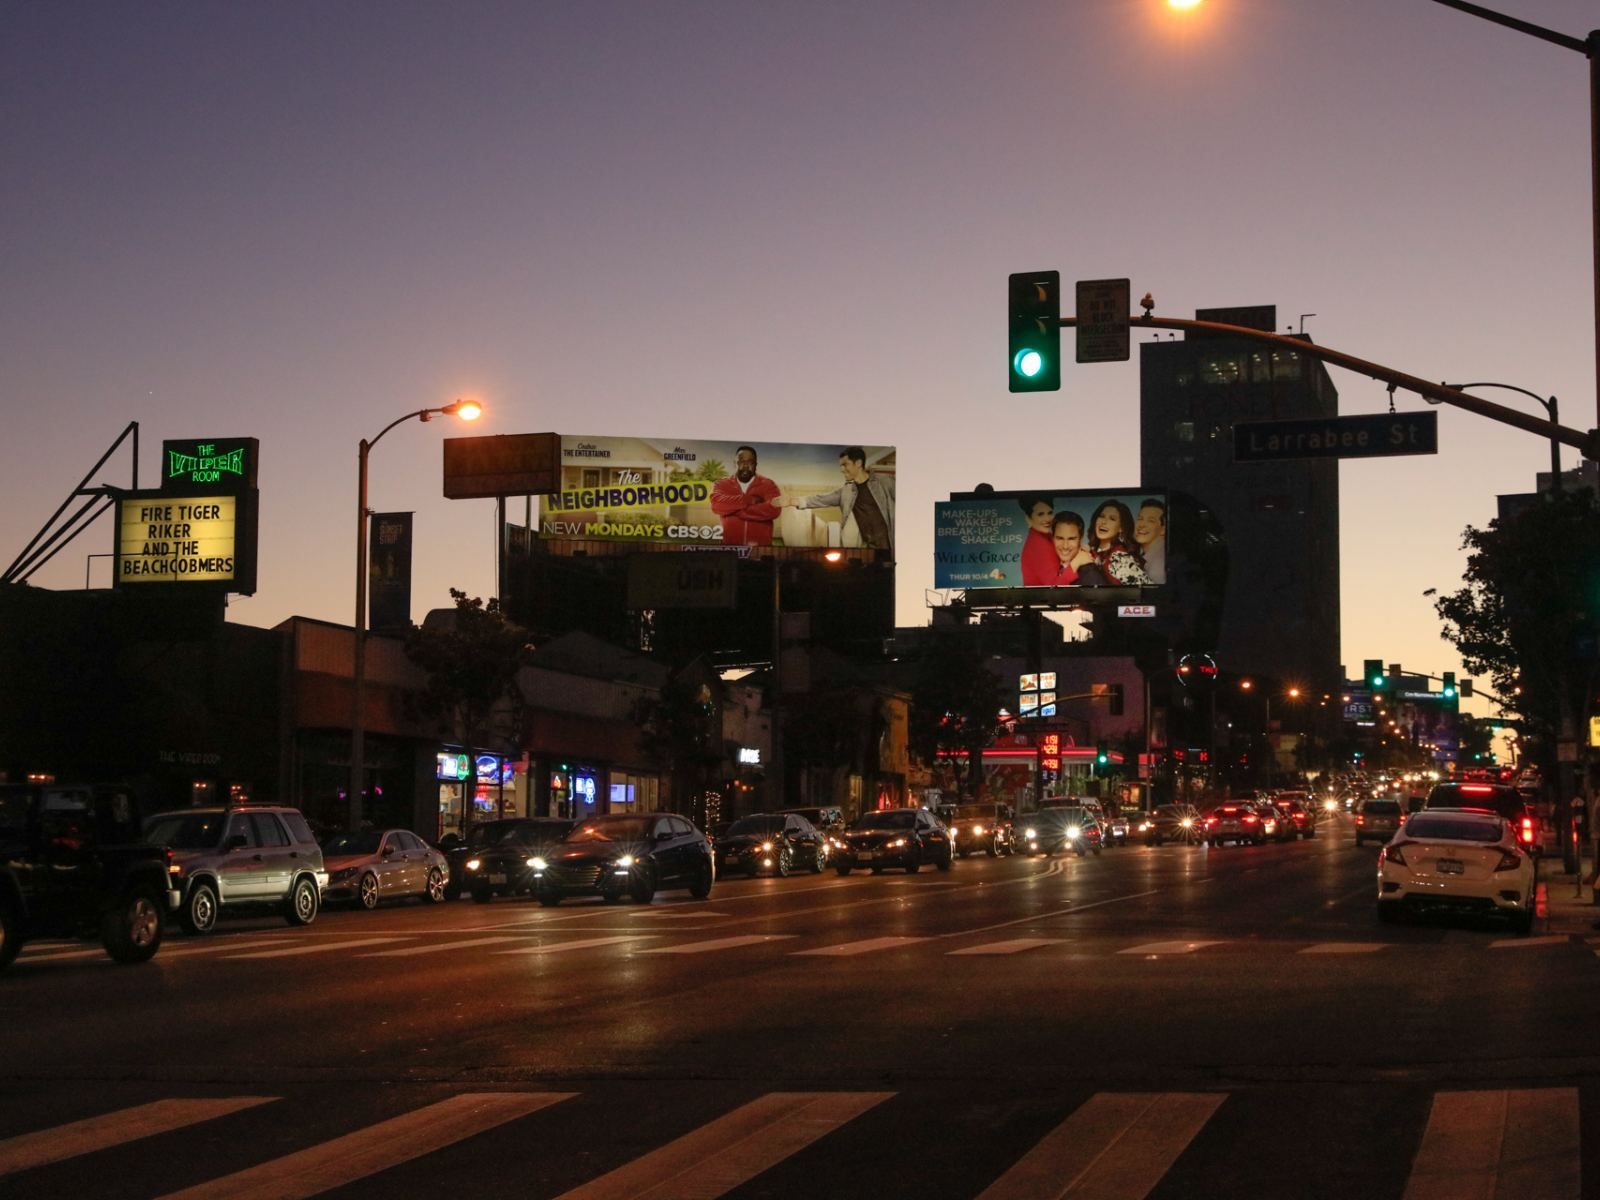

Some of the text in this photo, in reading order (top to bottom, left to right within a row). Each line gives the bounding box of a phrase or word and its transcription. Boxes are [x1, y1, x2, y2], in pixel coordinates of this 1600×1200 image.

[1250, 423, 1419, 452] Larrabee St
[197, 444, 215, 456] THE
[564, 449, 610, 458] THE ENTERTAINER
[168, 448, 244, 478] VIPER
[664, 453, 696, 461] GREENFIELD
[192, 471, 220, 482] ROOM
[618, 468, 641, 485] The
[548, 484, 708, 511] NEIGHBORHOOD
[141, 505, 220, 522] FIRE TIGER
[942, 508, 998, 519] MAKE-UPS
[955, 517, 1013, 527] WAKE-UPS
[148, 523, 191, 539] RIKER
[543, 521, 581, 535] NEW
[585, 522, 664, 538] MONDAYS
[938, 526, 999, 537] BREAK-UPS
[961, 535, 1023, 545] SHAKE-UPS
[142, 541, 199, 556] AND THE
[124, 557, 233, 575] BEACHCOBMERS
[1123, 607, 1151, 615] ACE
